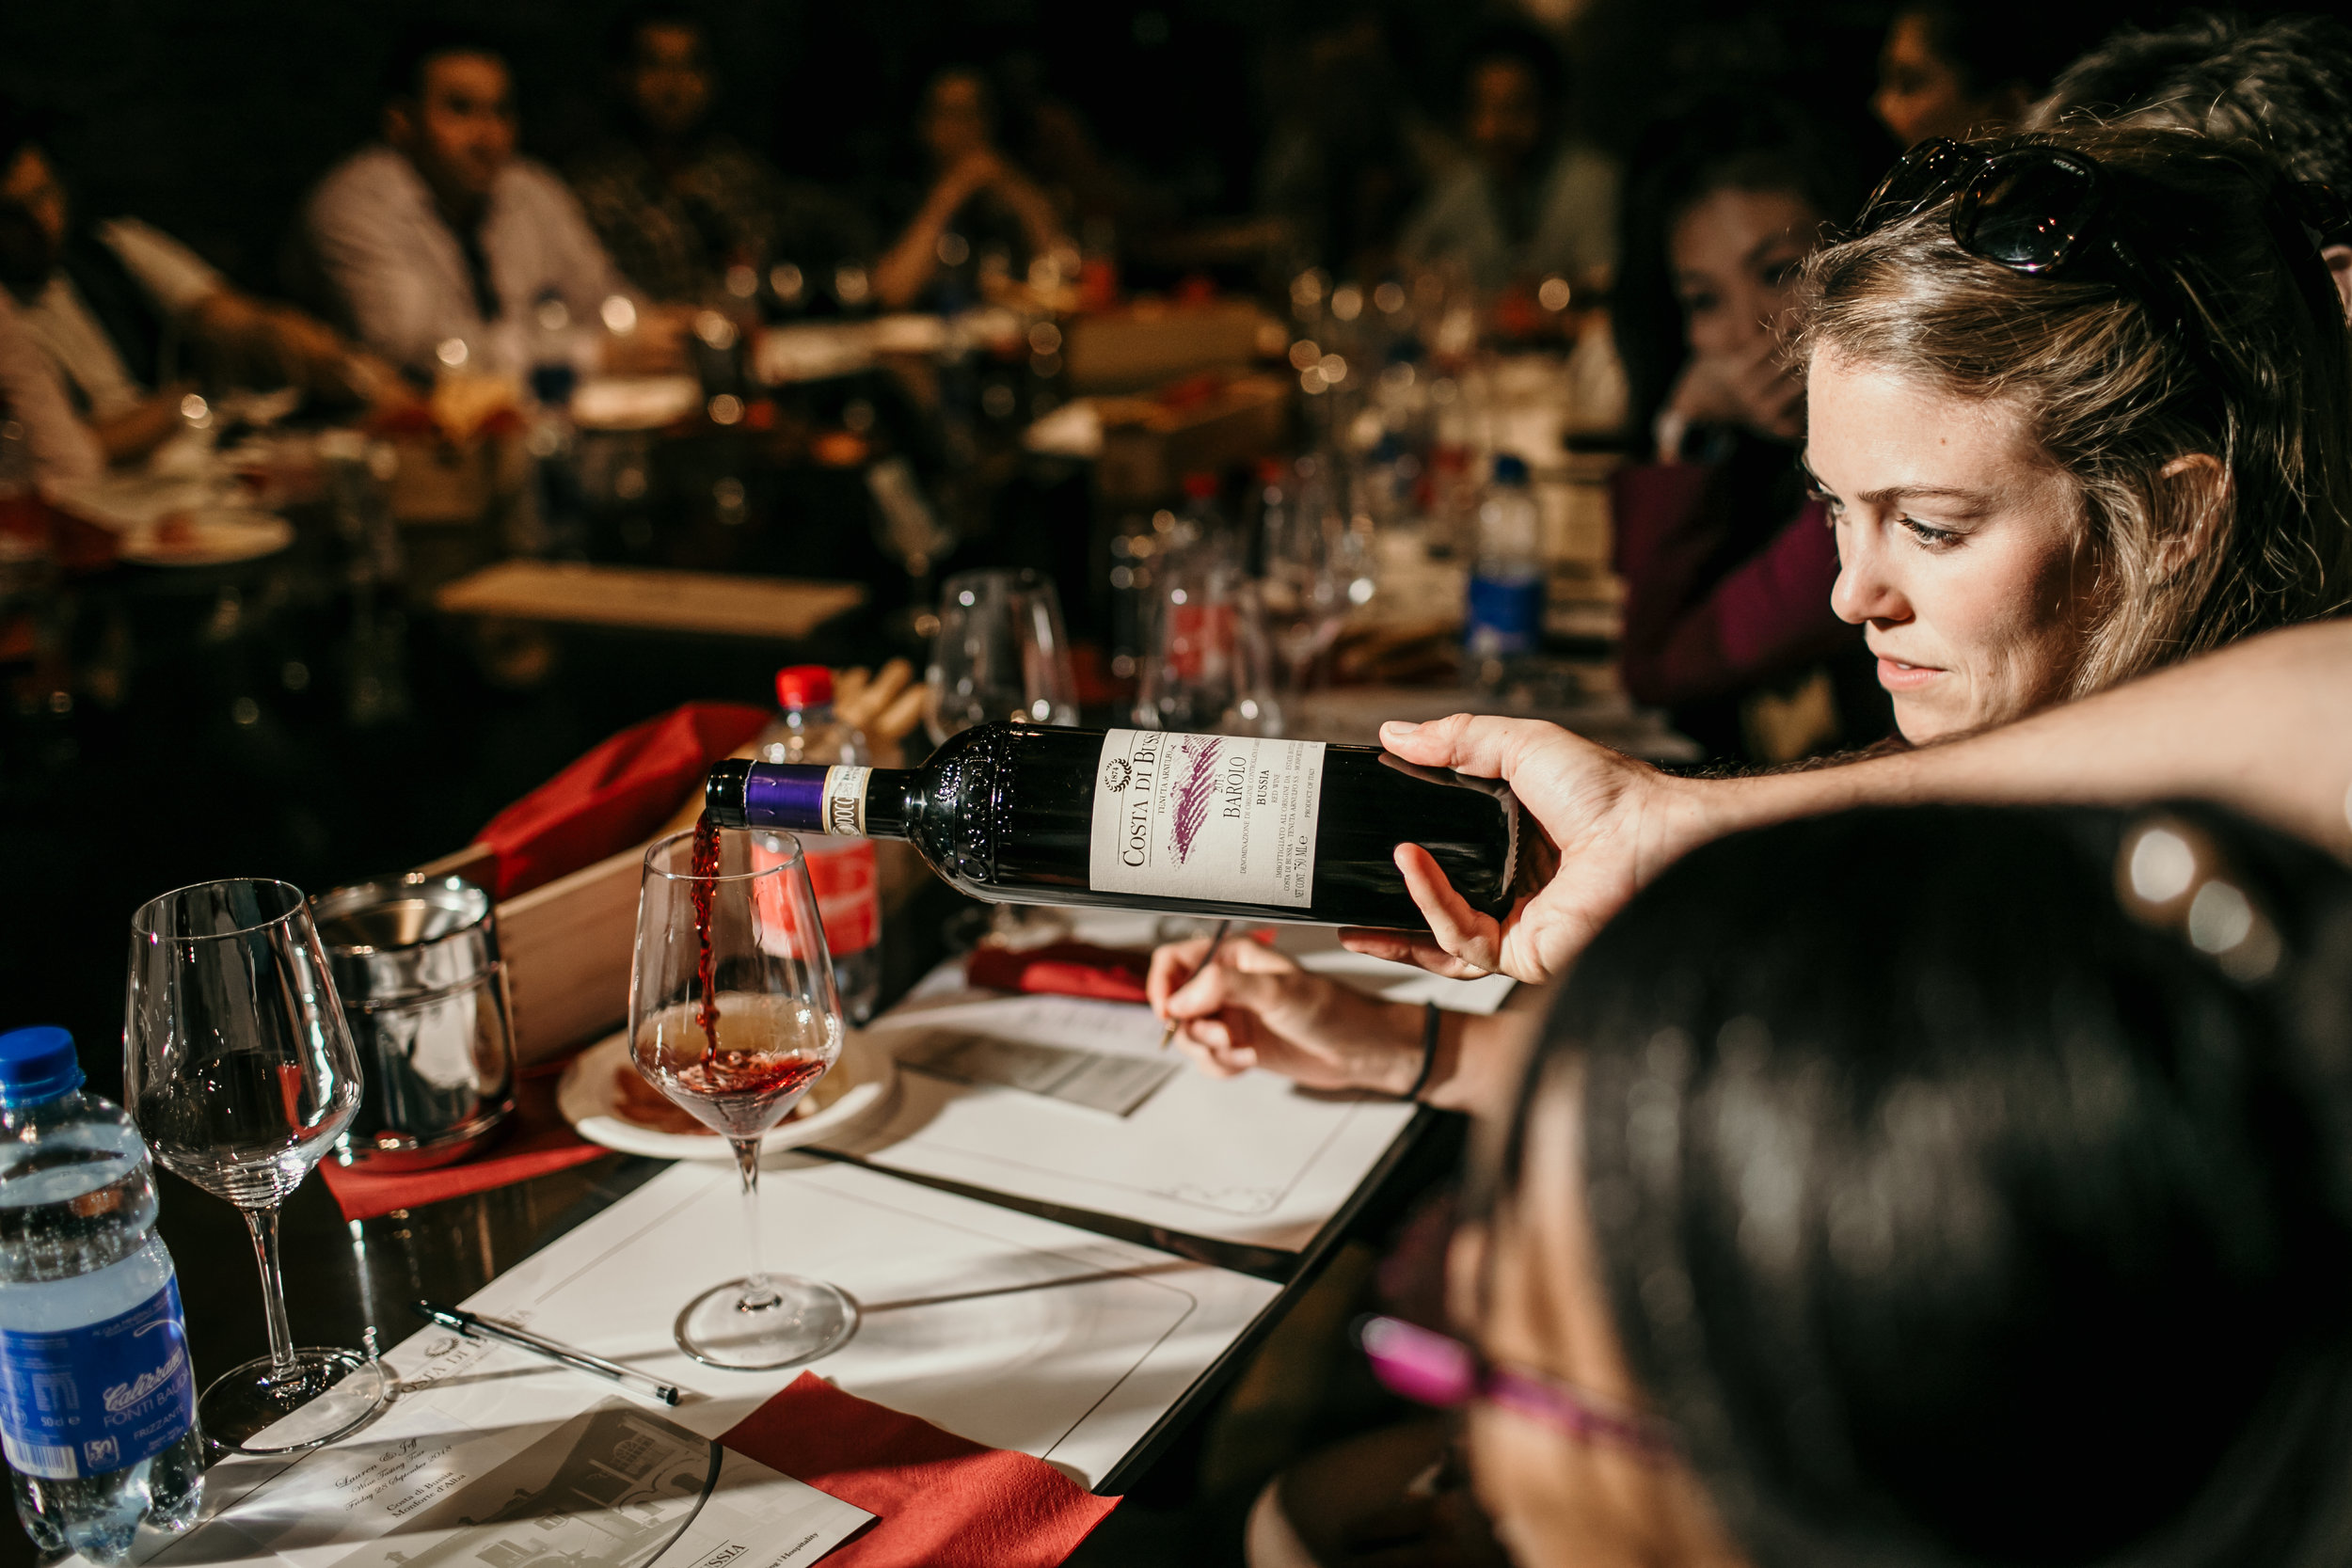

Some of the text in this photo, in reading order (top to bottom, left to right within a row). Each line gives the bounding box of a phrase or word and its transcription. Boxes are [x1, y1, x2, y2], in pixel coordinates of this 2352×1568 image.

[1111, 767, 1120, 784] 1874
[1214, 773, 1226, 794] 2013
[1223, 756, 1247, 819] BAROLO
[1257, 769, 1270, 806] BUSSIA
[1272, 773, 1280, 789] WINE
[1158, 782, 1168, 815] TENUTA
[1290, 784, 1299, 812] ARNULFO
[1304, 790, 1313, 818] PRODUCT
[1122, 800, 1149, 867] COSTA
[1136, 771, 1152, 792] DI
[1240, 820, 1250, 875] DENOMINAZIONE
[1246, 784, 1254, 810] ORIGINE
[1276, 827, 1286, 879] IMBOTTIGLIATO
[1283, 775, 1291, 784] DA
[1288, 814, 1296, 837] TENUTA
[1285, 844, 1294, 864] BUSSIA
[1294, 858, 1307, 871] 750
[1295, 846, 1308, 857] ML
[1283, 874, 1292, 892] COSTA
[103, 1399, 154, 1429] FONTI
[134, 1402, 186, 1440] FRIZZANTE
[335, 1437, 418, 1489] Lauren & Jeff
[345, 1445, 453, 1512] Friday 28 September 2018
[351, 1449, 425, 1494] Wine Tasting Tour
[387, 1470, 454, 1512] Costa di Bussia
[391, 1473, 467, 1518] Monforte d'Alba
[780, 1531, 819, 1560] Hospitality
